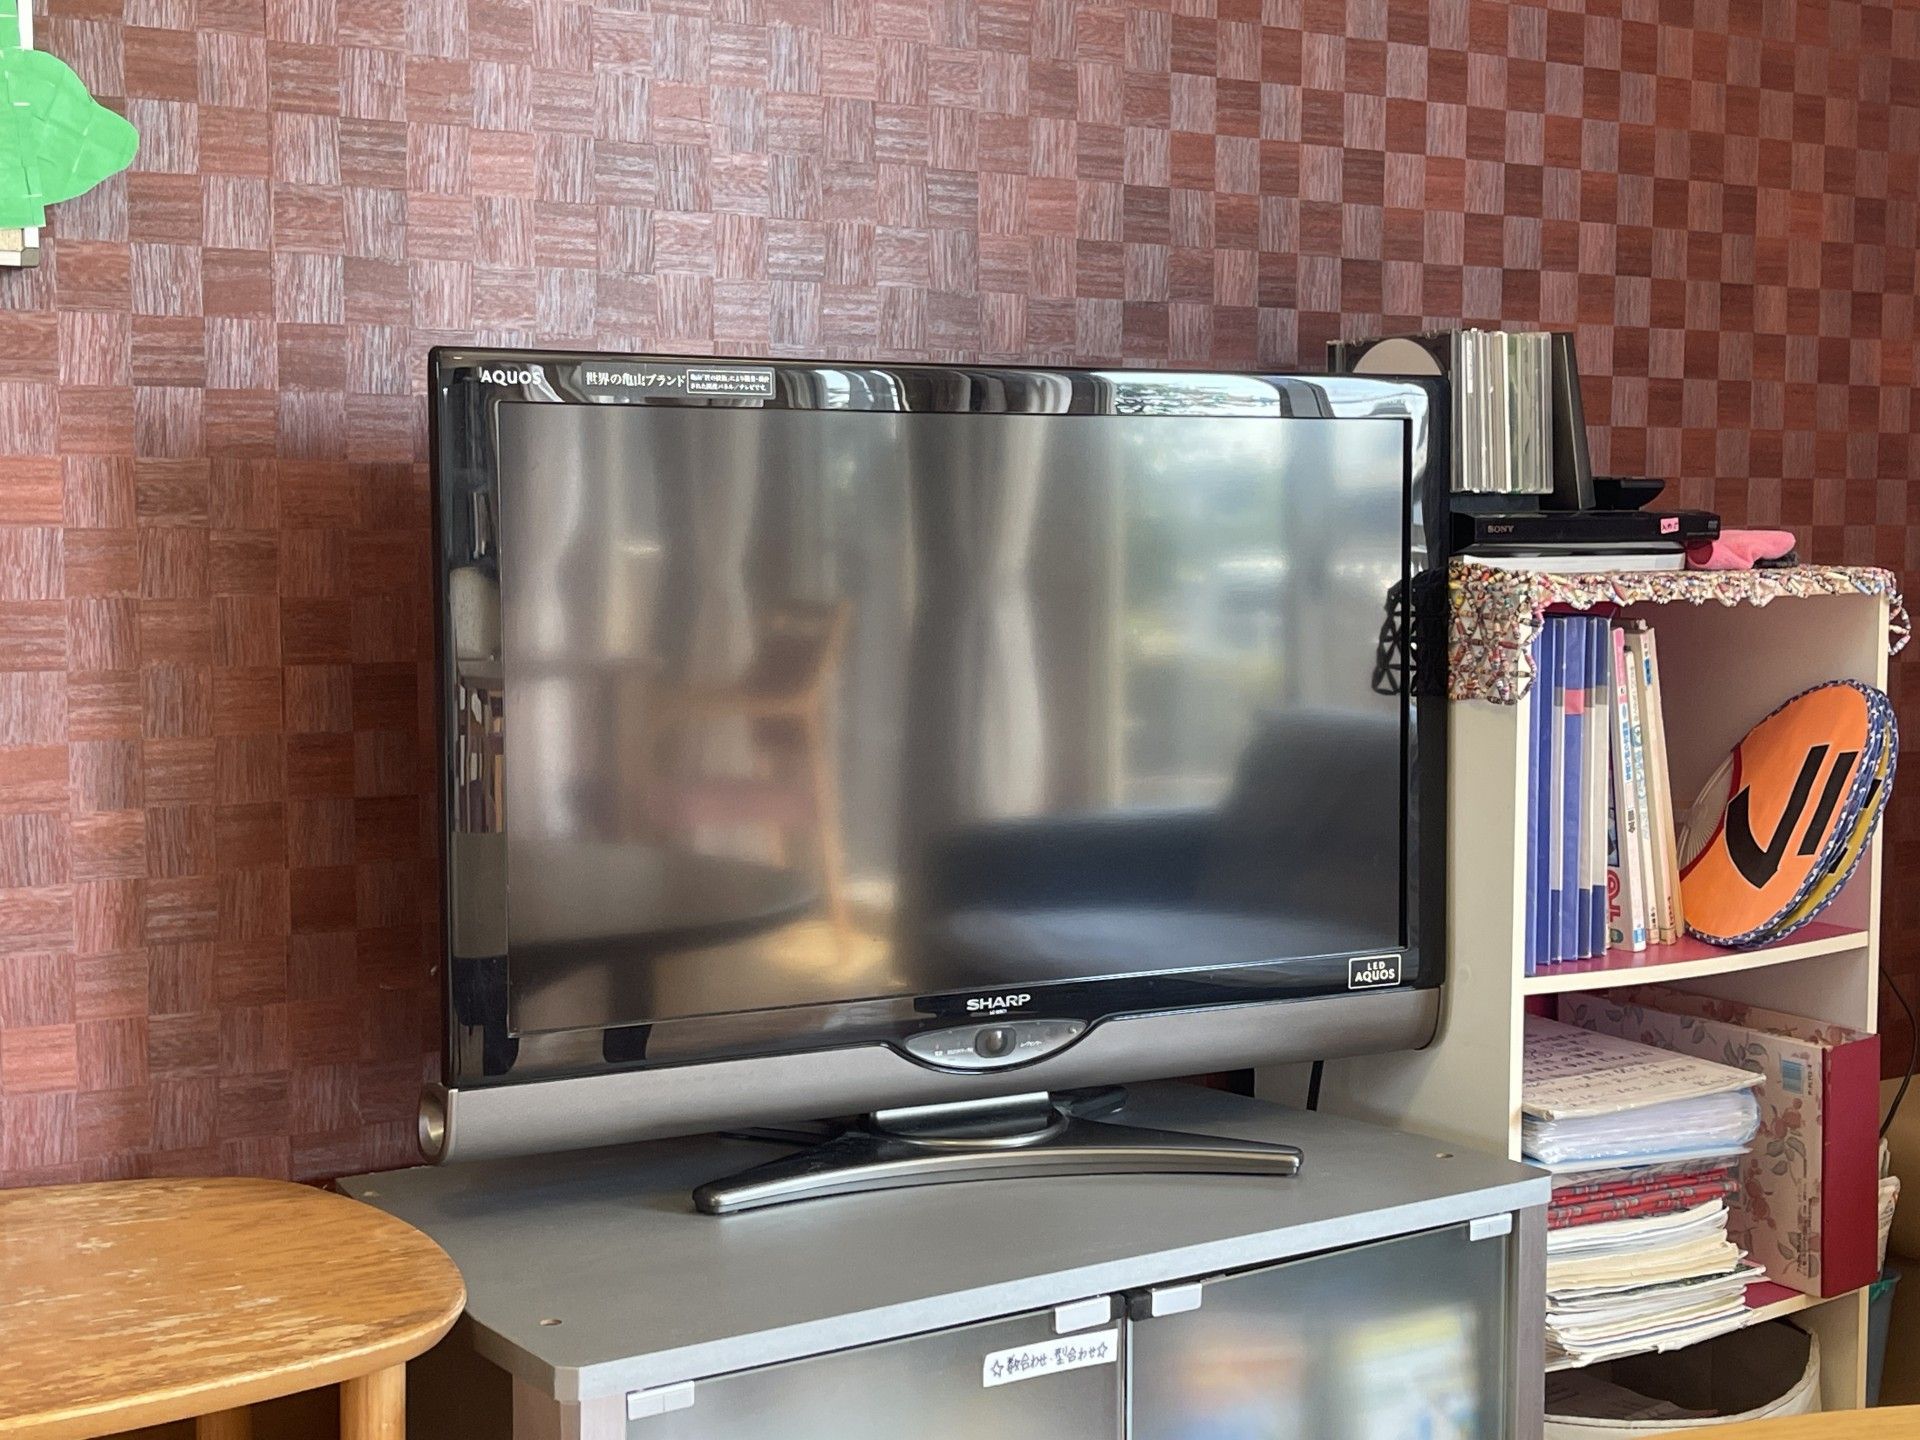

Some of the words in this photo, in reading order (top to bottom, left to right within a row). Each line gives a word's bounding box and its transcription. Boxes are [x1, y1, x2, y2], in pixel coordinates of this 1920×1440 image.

[480, 369, 542, 387] AQUOS
[586, 371, 686, 388] 世界の亀山ブランド
[1487, 525, 1515, 534] SONY
[1367, 961, 1386, 971] LED
[1354, 968, 1396, 983] AQUOS
[966, 993, 1032, 1011] SHARP
